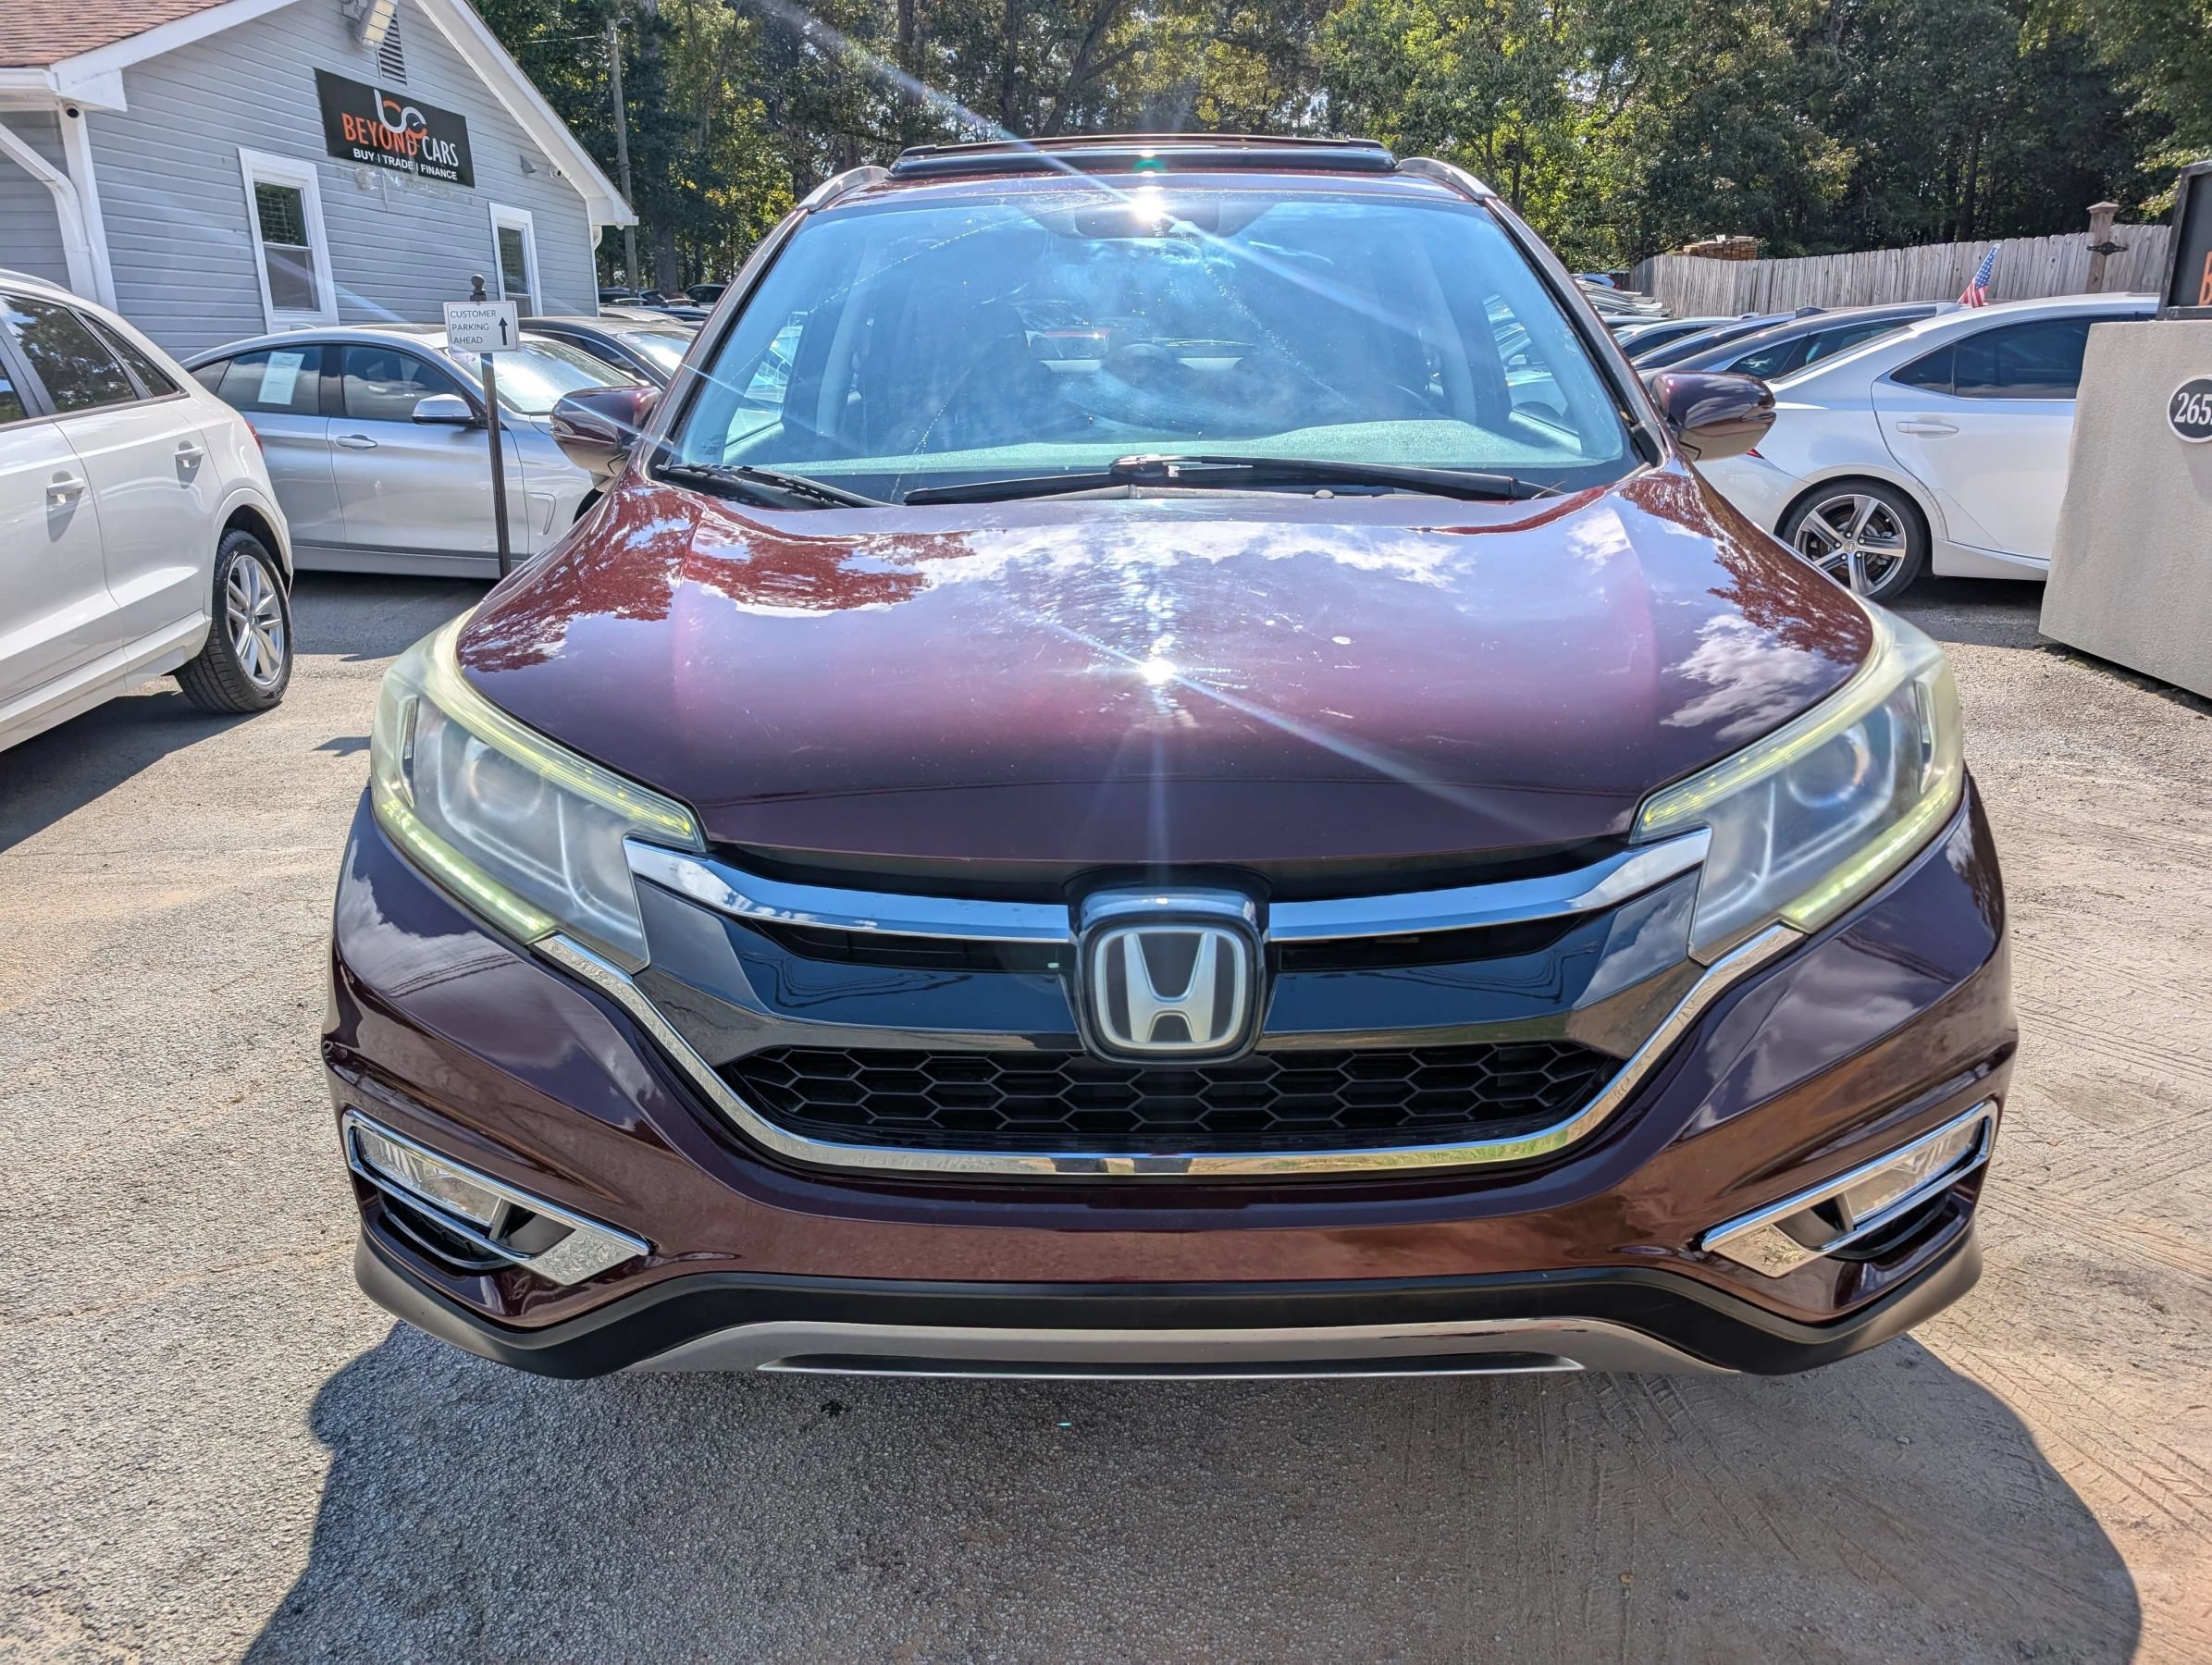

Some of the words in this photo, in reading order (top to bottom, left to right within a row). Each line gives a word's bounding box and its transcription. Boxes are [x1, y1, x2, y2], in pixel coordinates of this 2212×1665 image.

[341, 112, 419, 156] BEYOND
[422, 135, 459, 167] CARS
[352, 147, 375, 162] BUY
[382, 154, 414, 170] TRADE
[421, 164, 458, 180] FINANCE
[450, 309, 497, 318] CUSTOMER
[451, 323, 489, 331] PARKING
[453, 336, 483, 344] AHEAD
[2173, 392, 2212, 426] 265
